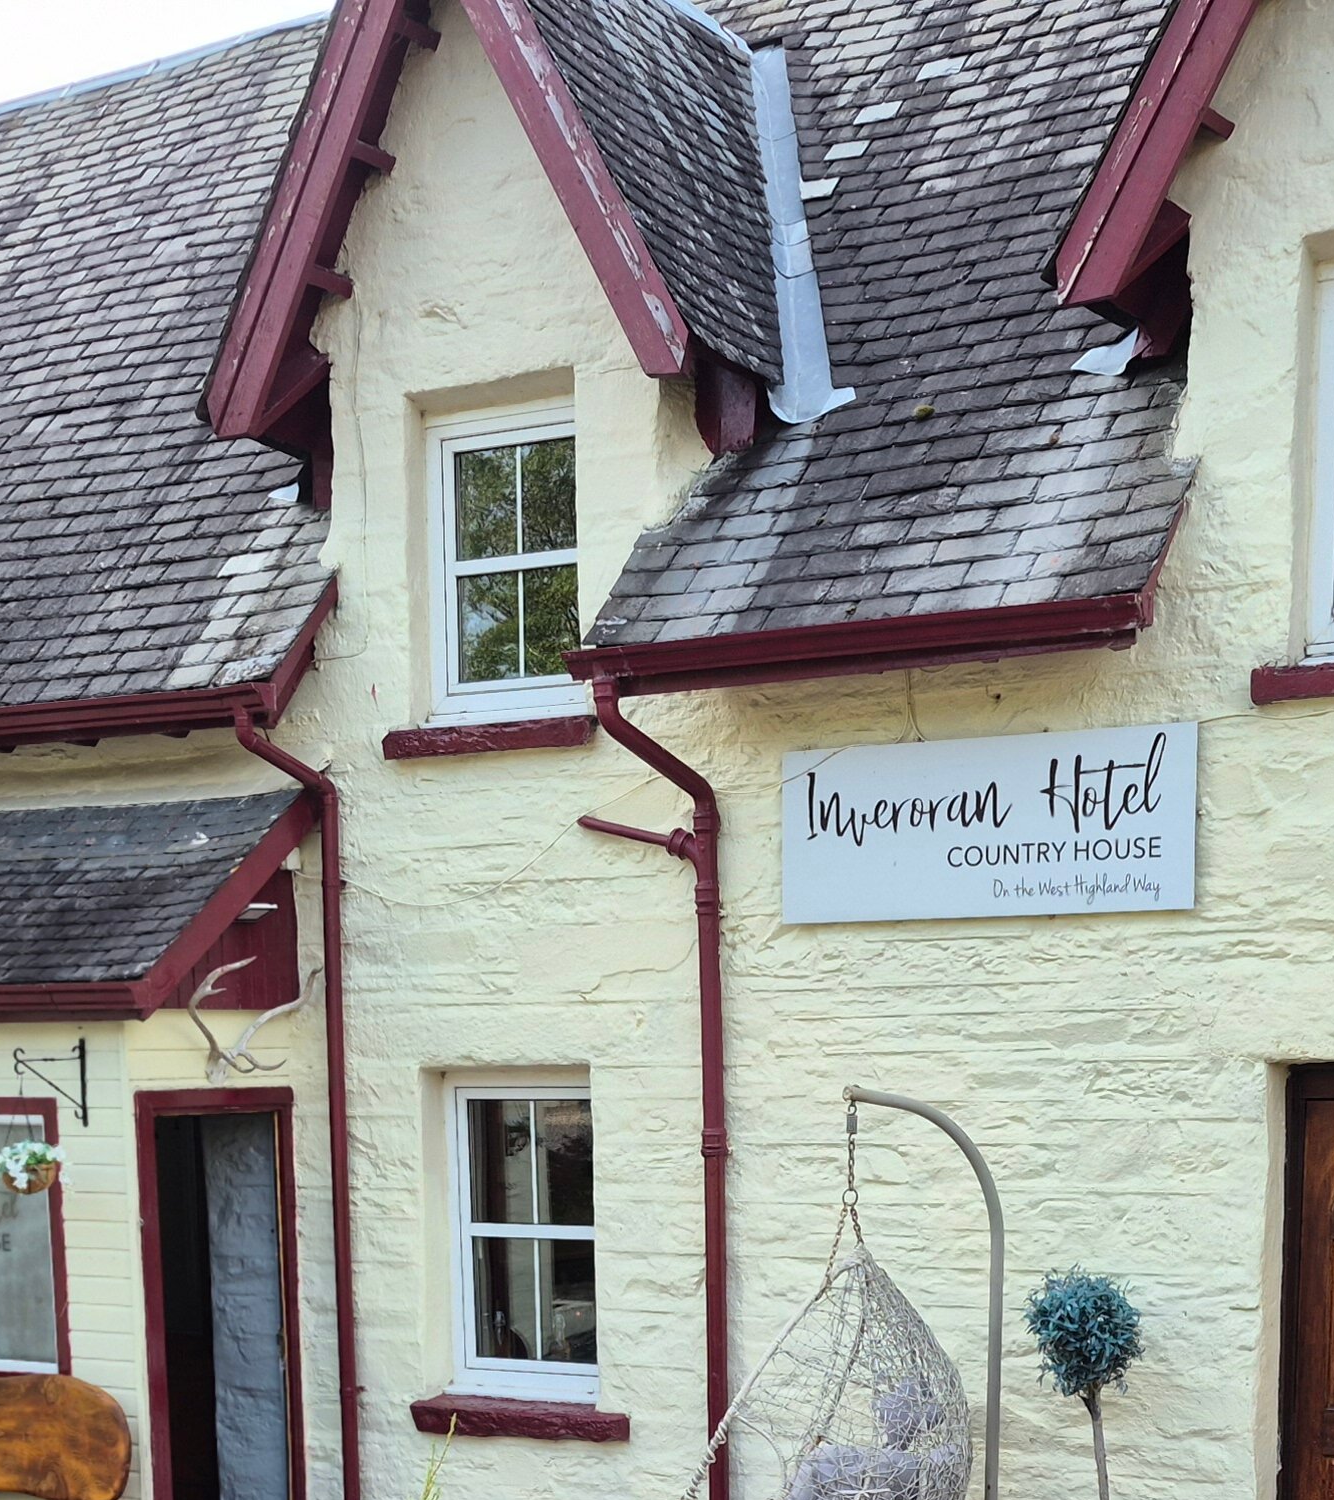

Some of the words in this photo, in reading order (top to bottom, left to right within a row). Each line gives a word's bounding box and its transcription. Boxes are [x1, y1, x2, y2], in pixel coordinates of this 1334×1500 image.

[806, 772, 1012, 847] Inveroran
[1040, 732, 1167, 833] Hotel
[947, 841, 1066, 868] COUNTRY
[1074, 836, 1162, 861] HOUSE
[993, 878, 1011, 899] On
[1014, 876, 1034, 897] the
[1038, 879, 1071, 897] West
[1074, 873, 1131, 905] Highland
[1133, 879, 1161, 900] Way
